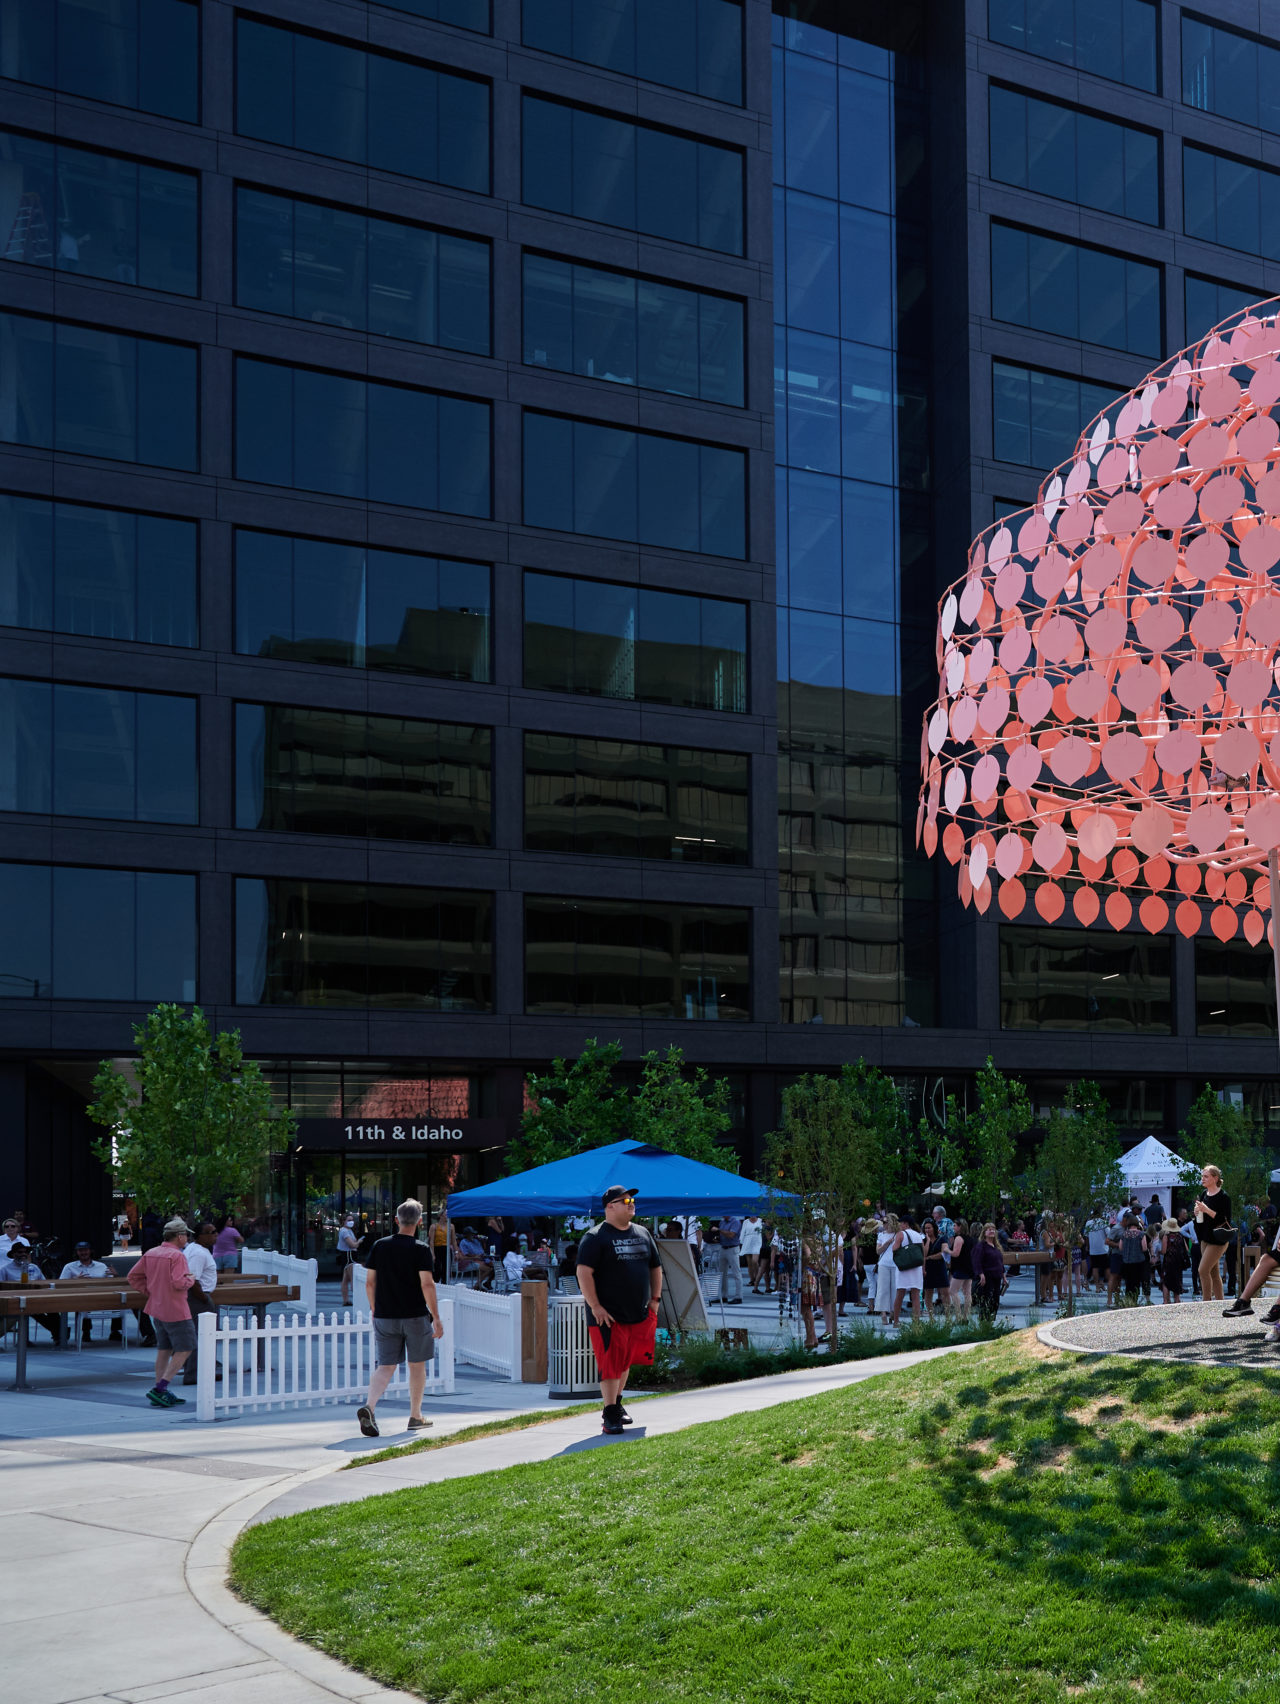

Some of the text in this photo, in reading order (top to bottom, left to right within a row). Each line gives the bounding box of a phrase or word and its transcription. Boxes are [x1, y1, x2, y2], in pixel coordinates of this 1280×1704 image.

[344, 1125, 463, 1140] 11th & Idaho
[612, 1238, 647, 1246] UNDER
